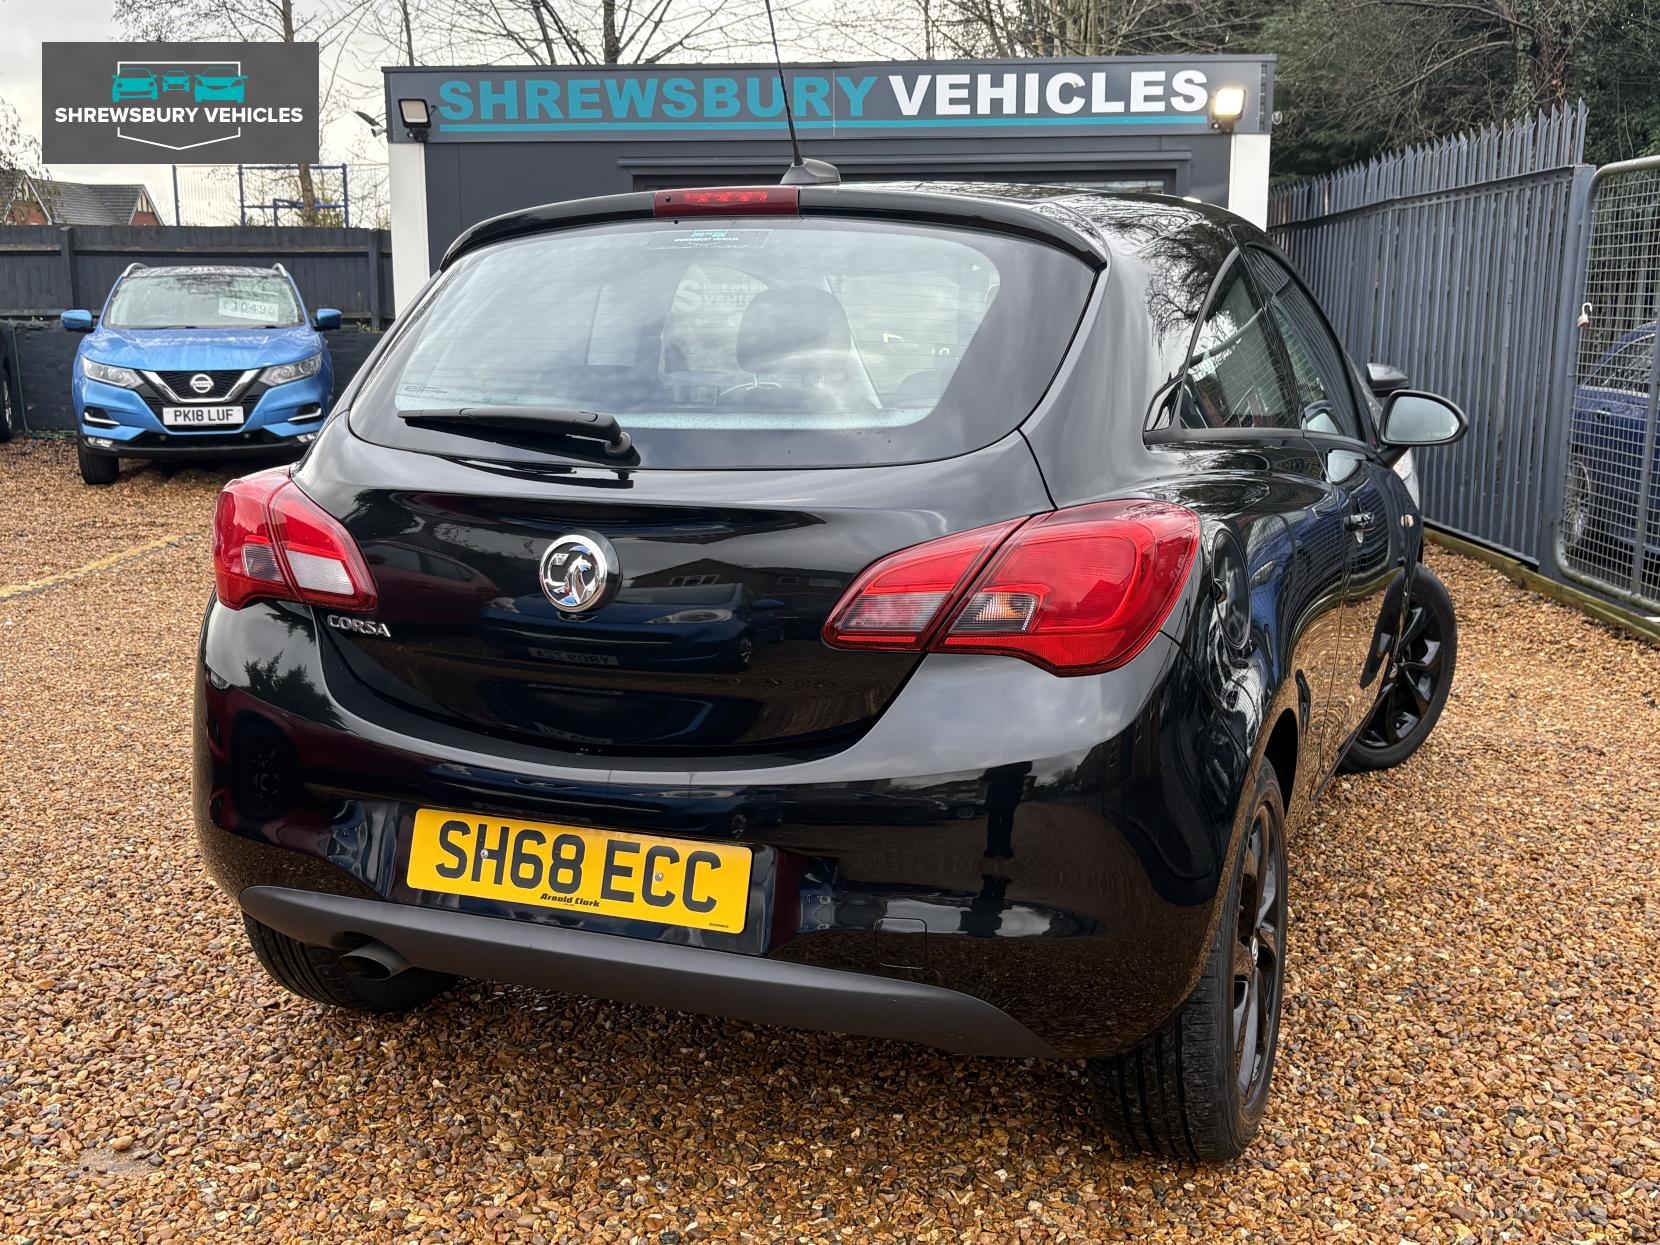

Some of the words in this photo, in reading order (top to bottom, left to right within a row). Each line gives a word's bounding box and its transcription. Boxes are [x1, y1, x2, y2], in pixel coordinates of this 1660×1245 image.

[439, 77, 877, 120] SHREWSBURY
[888, 69, 1208, 116] VEHICLES
[174, 409, 204, 422] PK18
[208, 409, 234, 422] LUF
[327, 614, 391, 638] CORSA
[435, 820, 585, 895] SH68
[600, 839, 722, 914] ECC
[540, 893, 574, 904] Arnold
[574, 897, 600, 907] Clark
